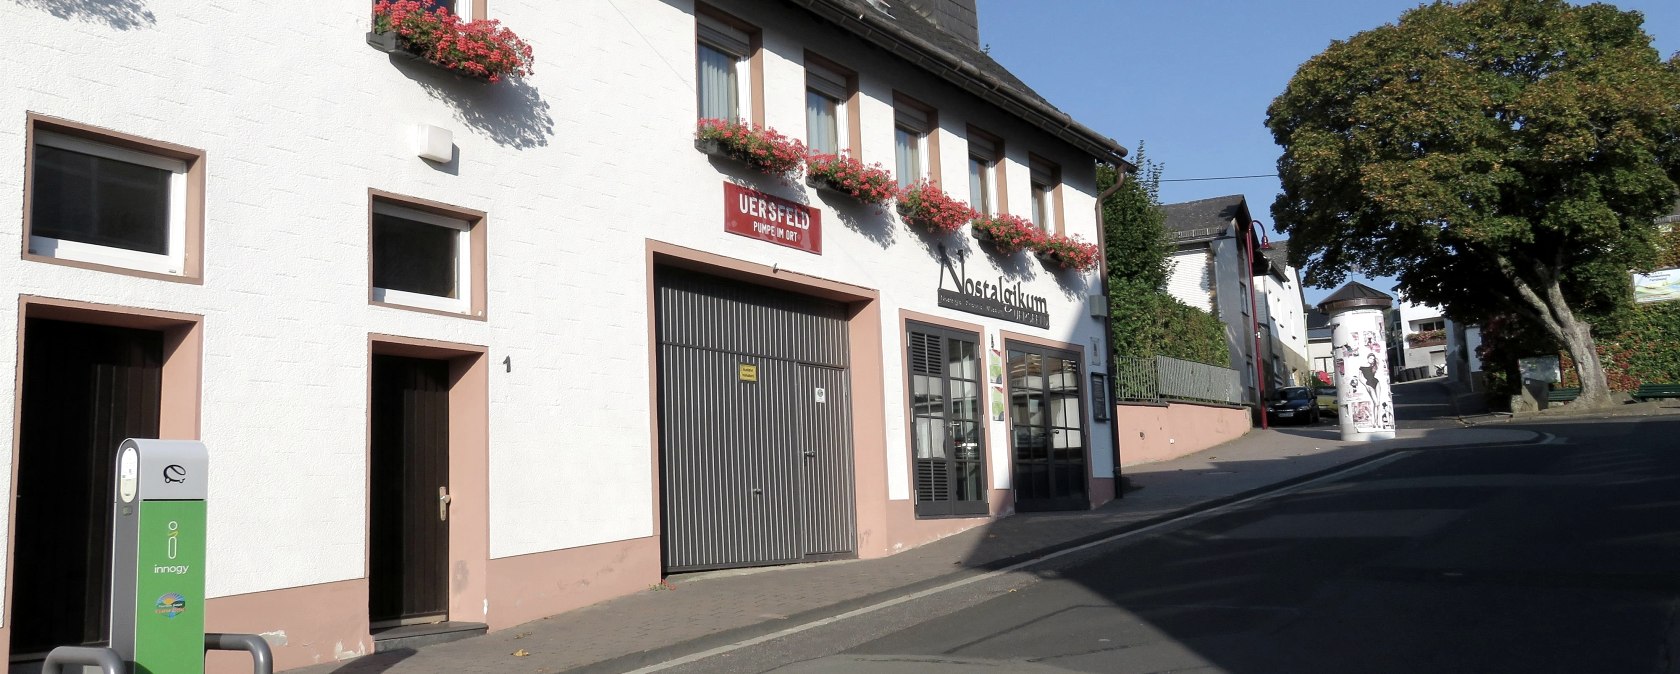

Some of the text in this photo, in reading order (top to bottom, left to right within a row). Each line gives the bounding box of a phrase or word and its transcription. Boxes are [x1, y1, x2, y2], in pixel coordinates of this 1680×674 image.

[739, 193, 810, 230] UERSFELD
[753, 221, 798, 242] PUMPE IM ORT
[938, 243, 1048, 314] Nostalgikum
[502, 354, 512, 373] 1
[153, 563, 190, 575] innogy
